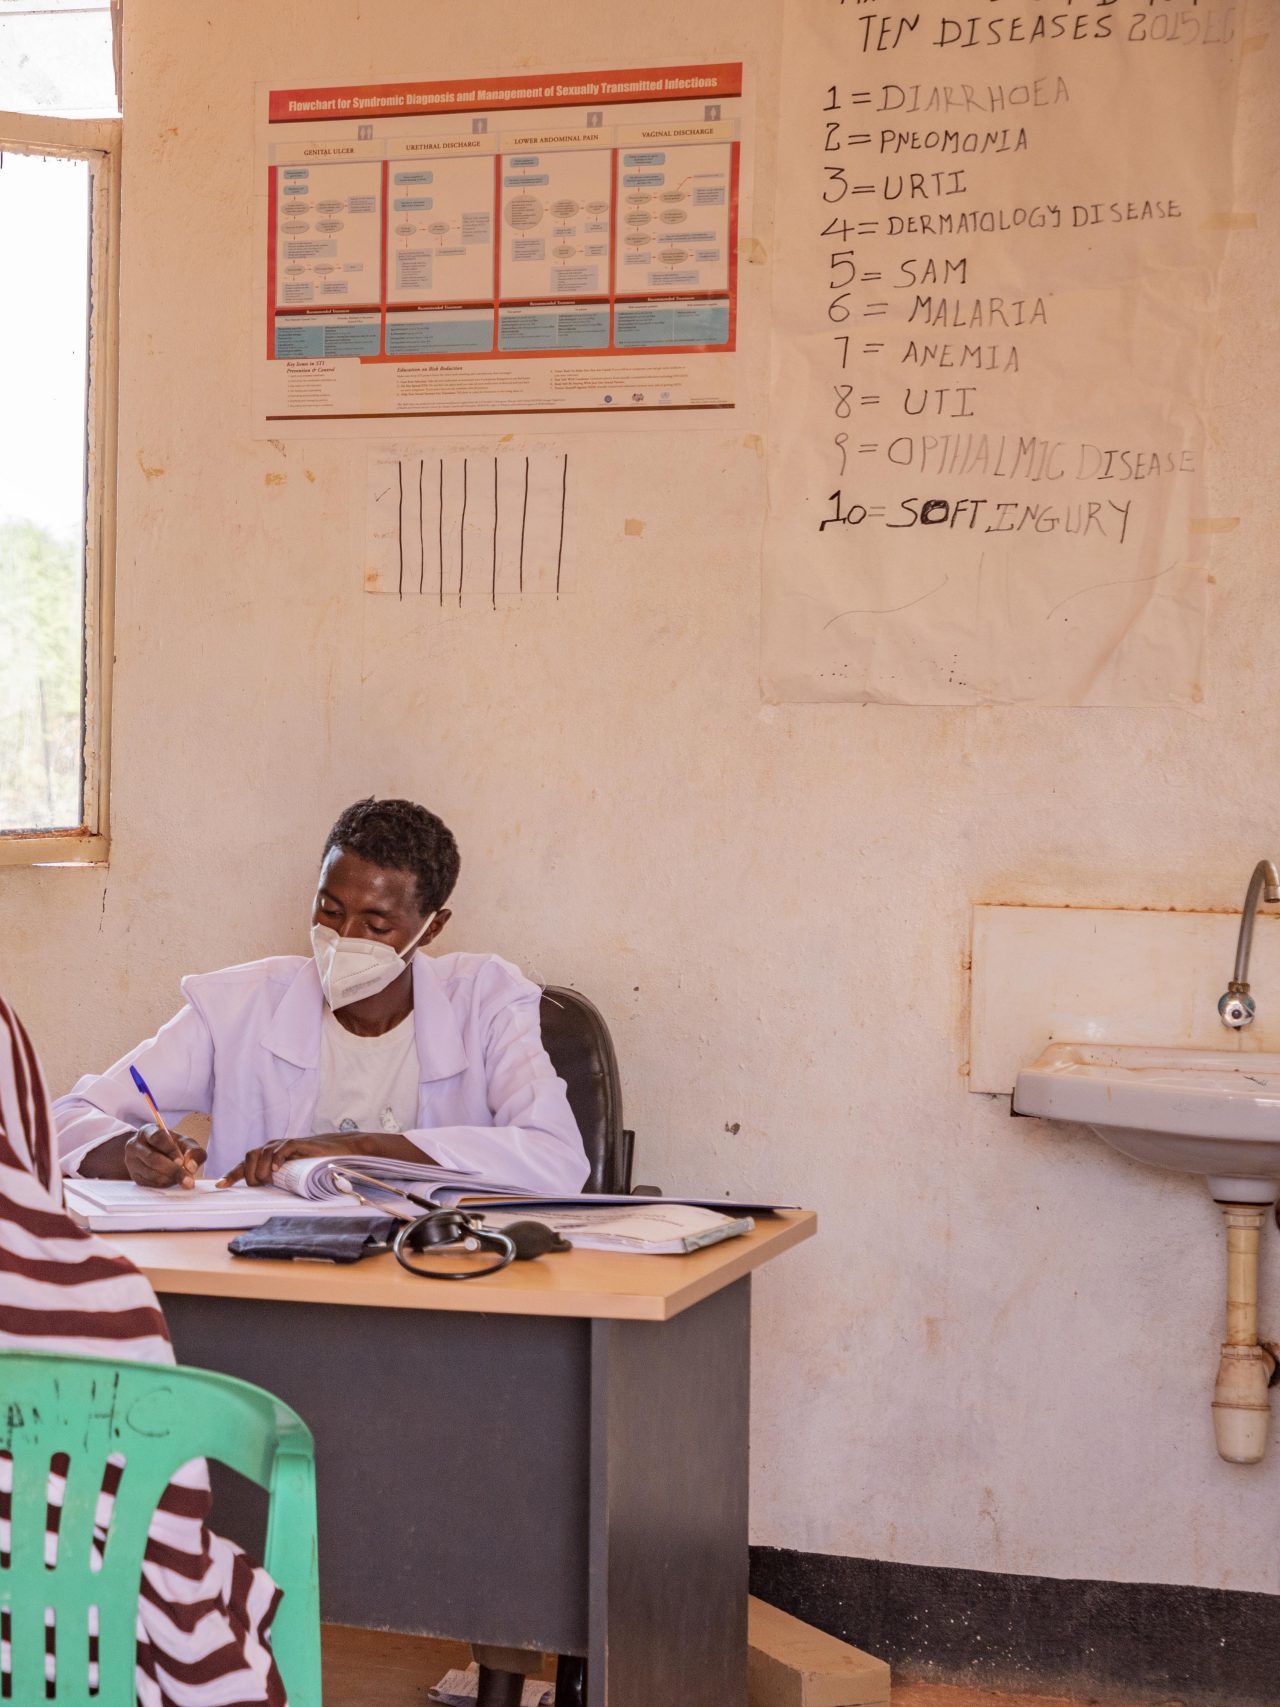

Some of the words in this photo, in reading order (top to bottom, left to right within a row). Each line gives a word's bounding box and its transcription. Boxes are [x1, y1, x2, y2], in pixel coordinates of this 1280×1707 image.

[859, 14, 921, 53] TEN
[932, 13, 1113, 48] DISEASES
[288, 98, 336, 112] Flowchart
[337, 98, 350, 110] for
[352, 95, 404, 109] Syndromic
[406, 92, 455, 106] Diagnosis
[457, 90, 475, 102] and
[477, 87, 542, 102] Management
[544, 86, 555, 97] of
[556, 83, 600, 97] Sexually
[601, 79, 663, 95] Transmitted
[665, 76, 718, 90] Infections
[875, 76, 1070, 114] DIARRHOEA
[406, 143, 441, 151] URETHRAL
[442, 141, 481, 149] DISCHARGE
[514, 137, 538, 145] LOWER
[540, 135, 581, 143] ABDOMINAL
[673, 128, 714, 136] DISCHARGE
[880, 128, 1029, 154] PNEOMONIA
[883, 170, 968, 201] URTI
[886, 204, 1062, 236] DERMATOLOGY
[1072, 200, 1183, 228] DISEASE
[893, 258, 967, 289] SAM
[908, 294, 1048, 328] MALARIA
[901, 341, 1020, 373] ANEMIA
[903, 387, 977, 417] UTI
[1075, 442, 1197, 482] DISEASE
[886, 497, 987, 528] SOFT
